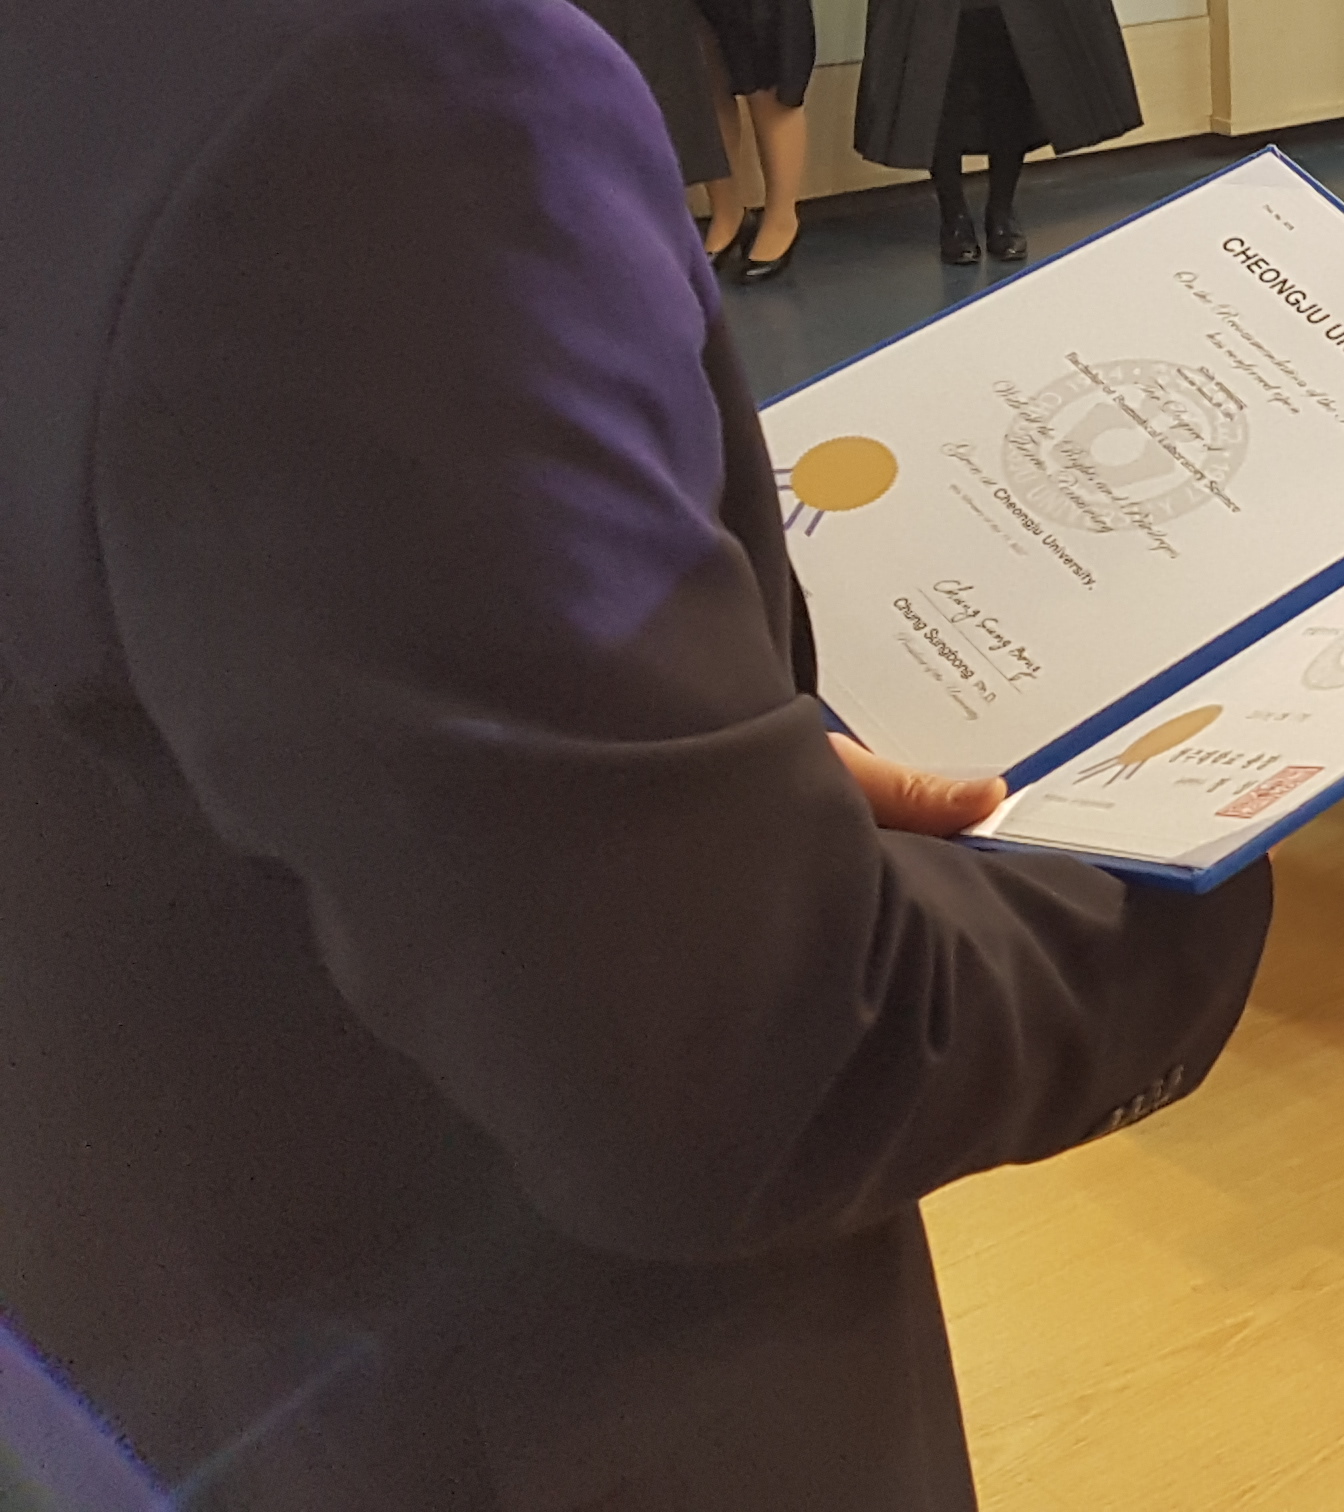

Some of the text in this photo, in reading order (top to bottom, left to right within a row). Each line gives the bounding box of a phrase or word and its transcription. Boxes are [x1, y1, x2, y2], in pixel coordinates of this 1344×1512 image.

[1222, 236, 1331, 325] CHEONGJU
[993, 487, 1045, 536] Cheongju
[892, 596, 929, 632] Chung
